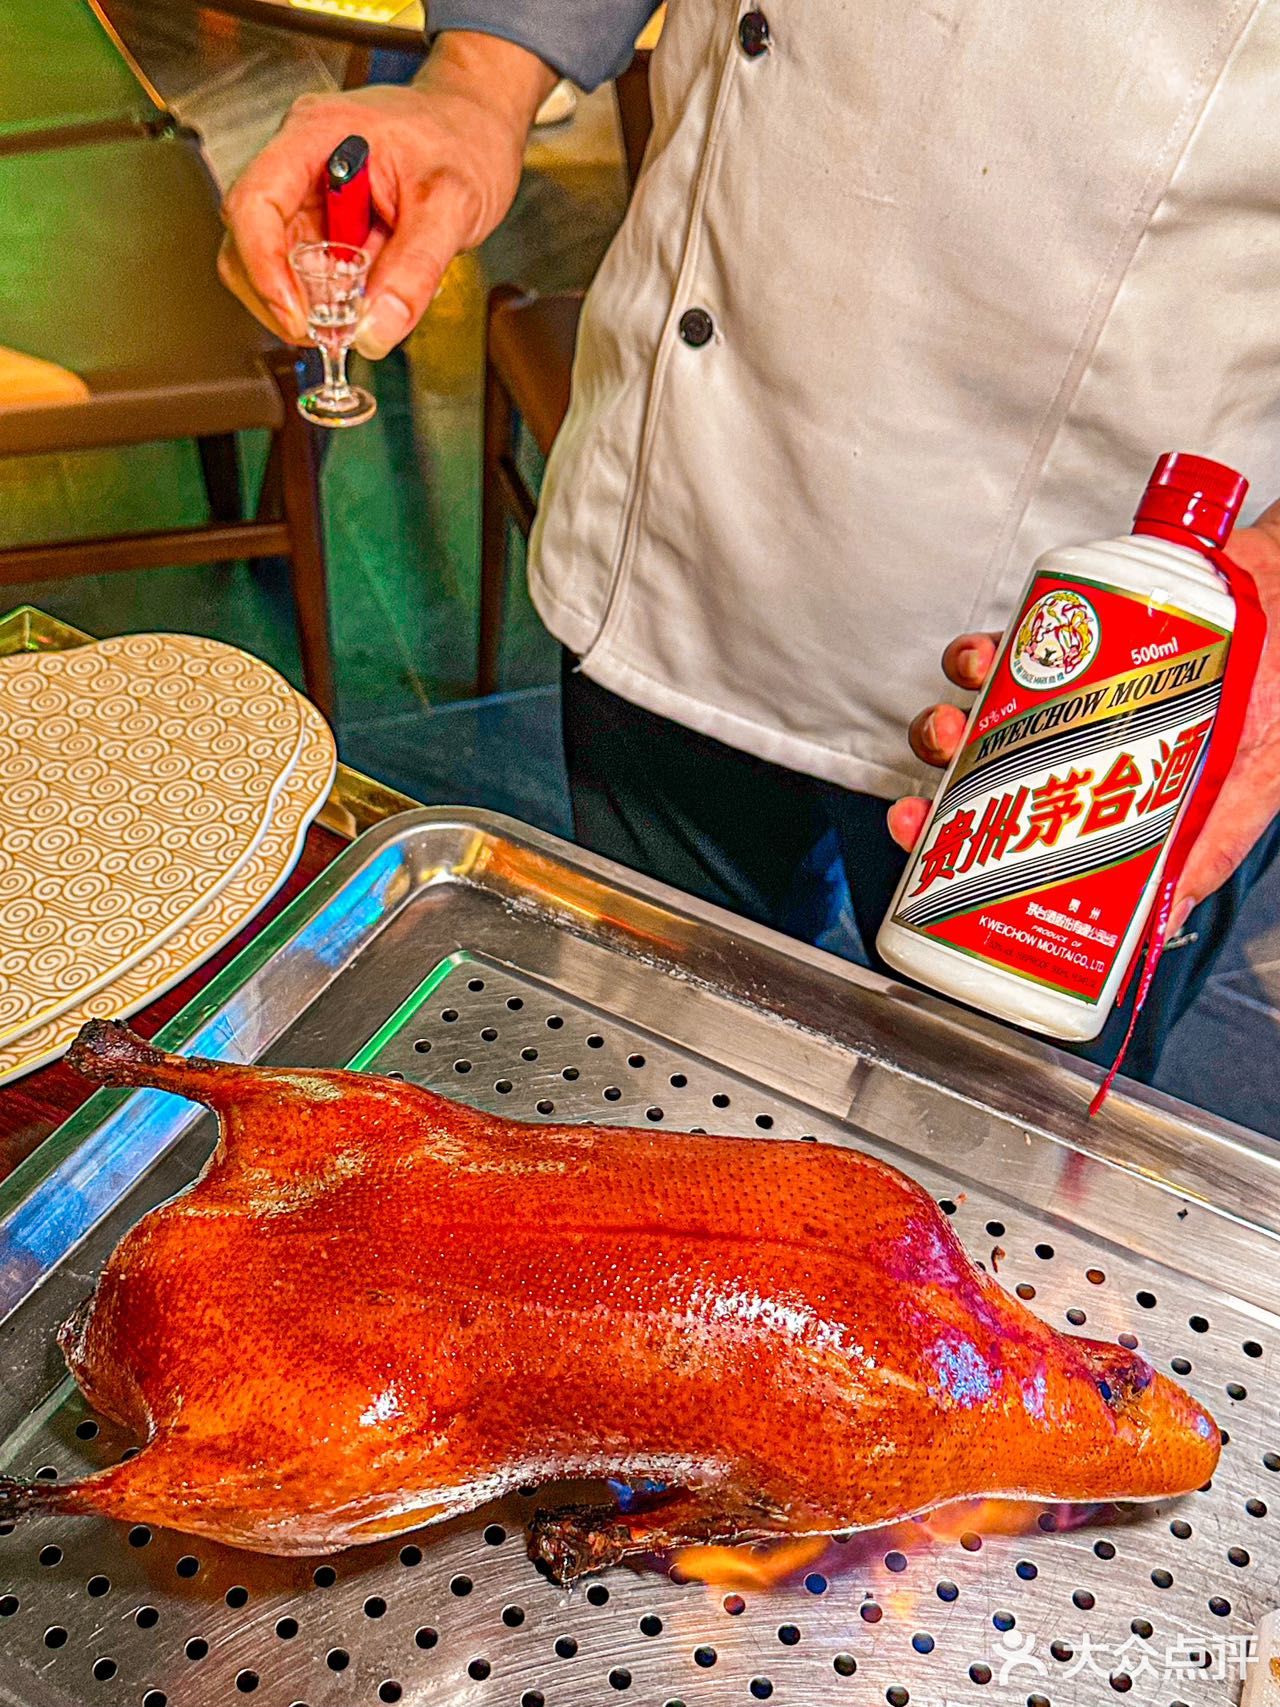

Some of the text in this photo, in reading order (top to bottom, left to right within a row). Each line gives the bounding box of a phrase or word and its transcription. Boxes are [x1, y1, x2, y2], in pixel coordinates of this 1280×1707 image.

[1131, 637, 1179, 665] 500ml
[975, 655, 1211, 763] KWEICHOW MOUTAI
[1001, 698, 1017, 717] vol
[908, 716, 1216, 898] 贵州茅台酒
[978, 915, 1038, 947] KWEICHOW
[1036, 938, 1075, 962] MOUTAI
[1031, 925, 1084, 948] PRODUCE OF
